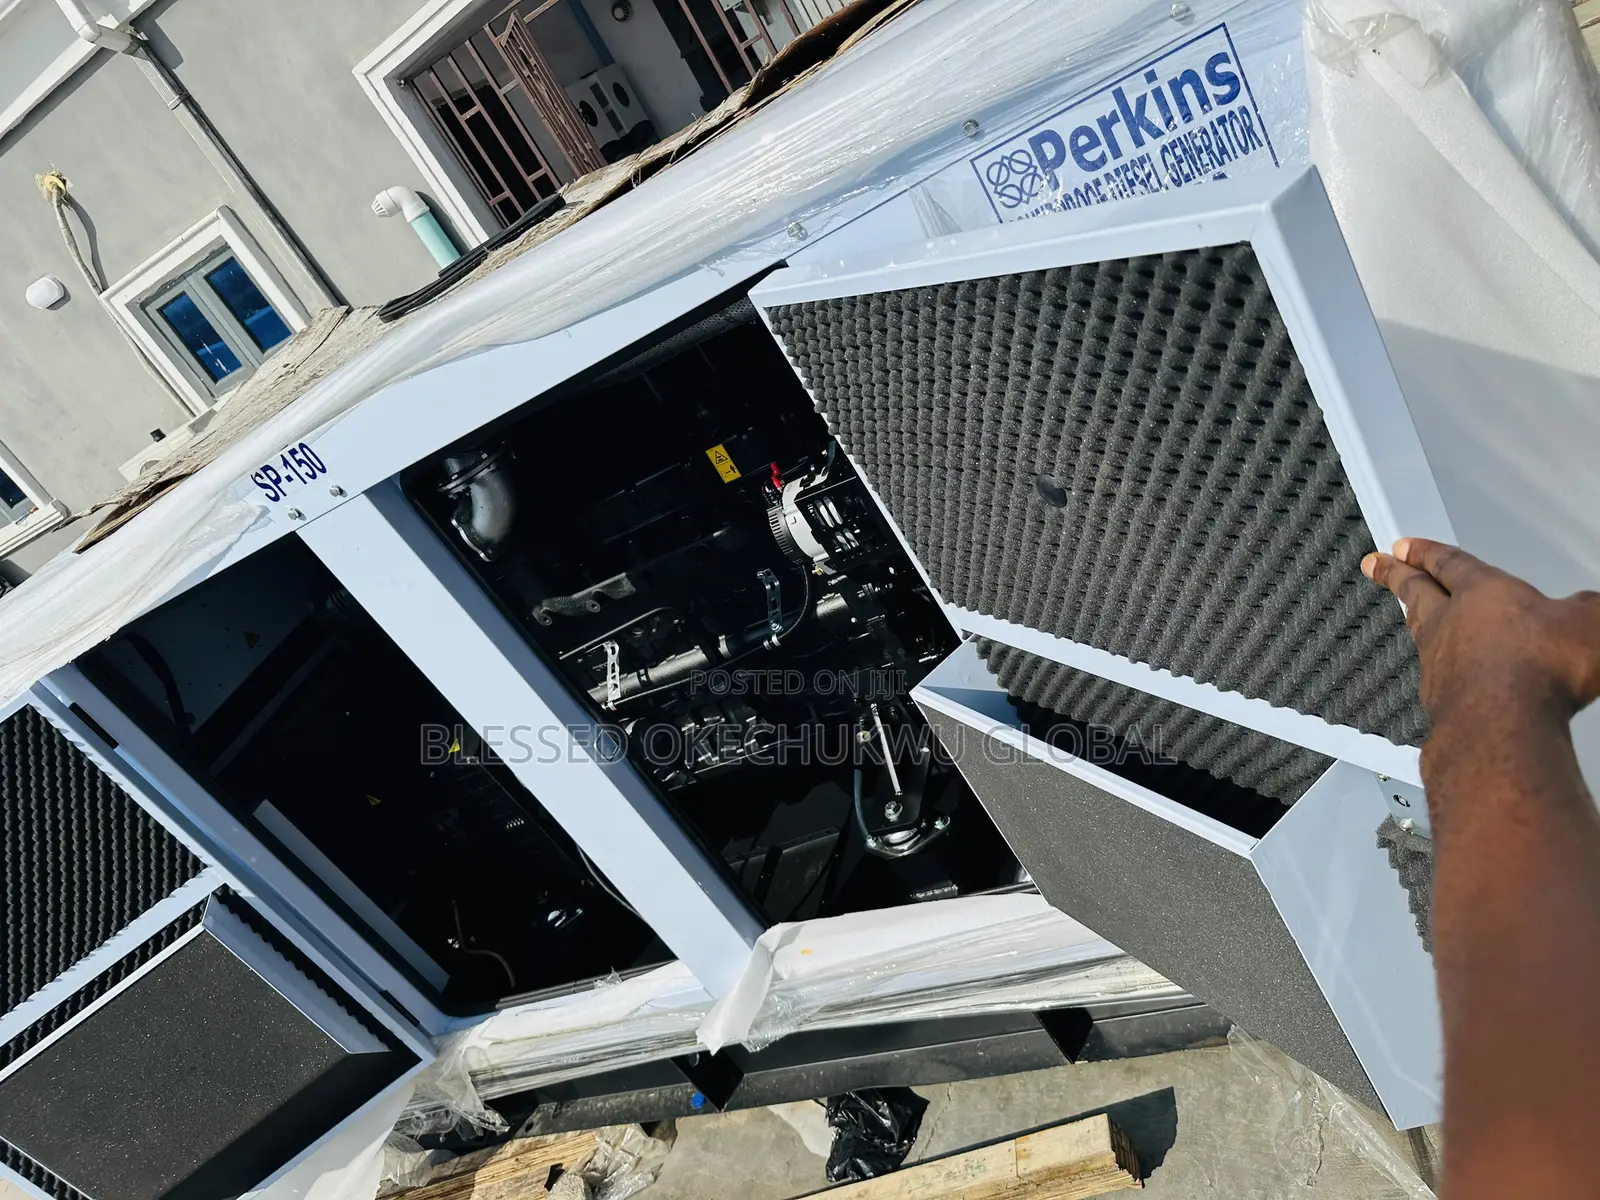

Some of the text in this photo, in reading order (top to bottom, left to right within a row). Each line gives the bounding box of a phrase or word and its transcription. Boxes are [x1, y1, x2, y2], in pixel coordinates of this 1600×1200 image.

[1028, 52, 1242, 191] Perkins
[1160, 105, 1264, 188] GENERATOR
[250, 442, 327, 502] SP-150
